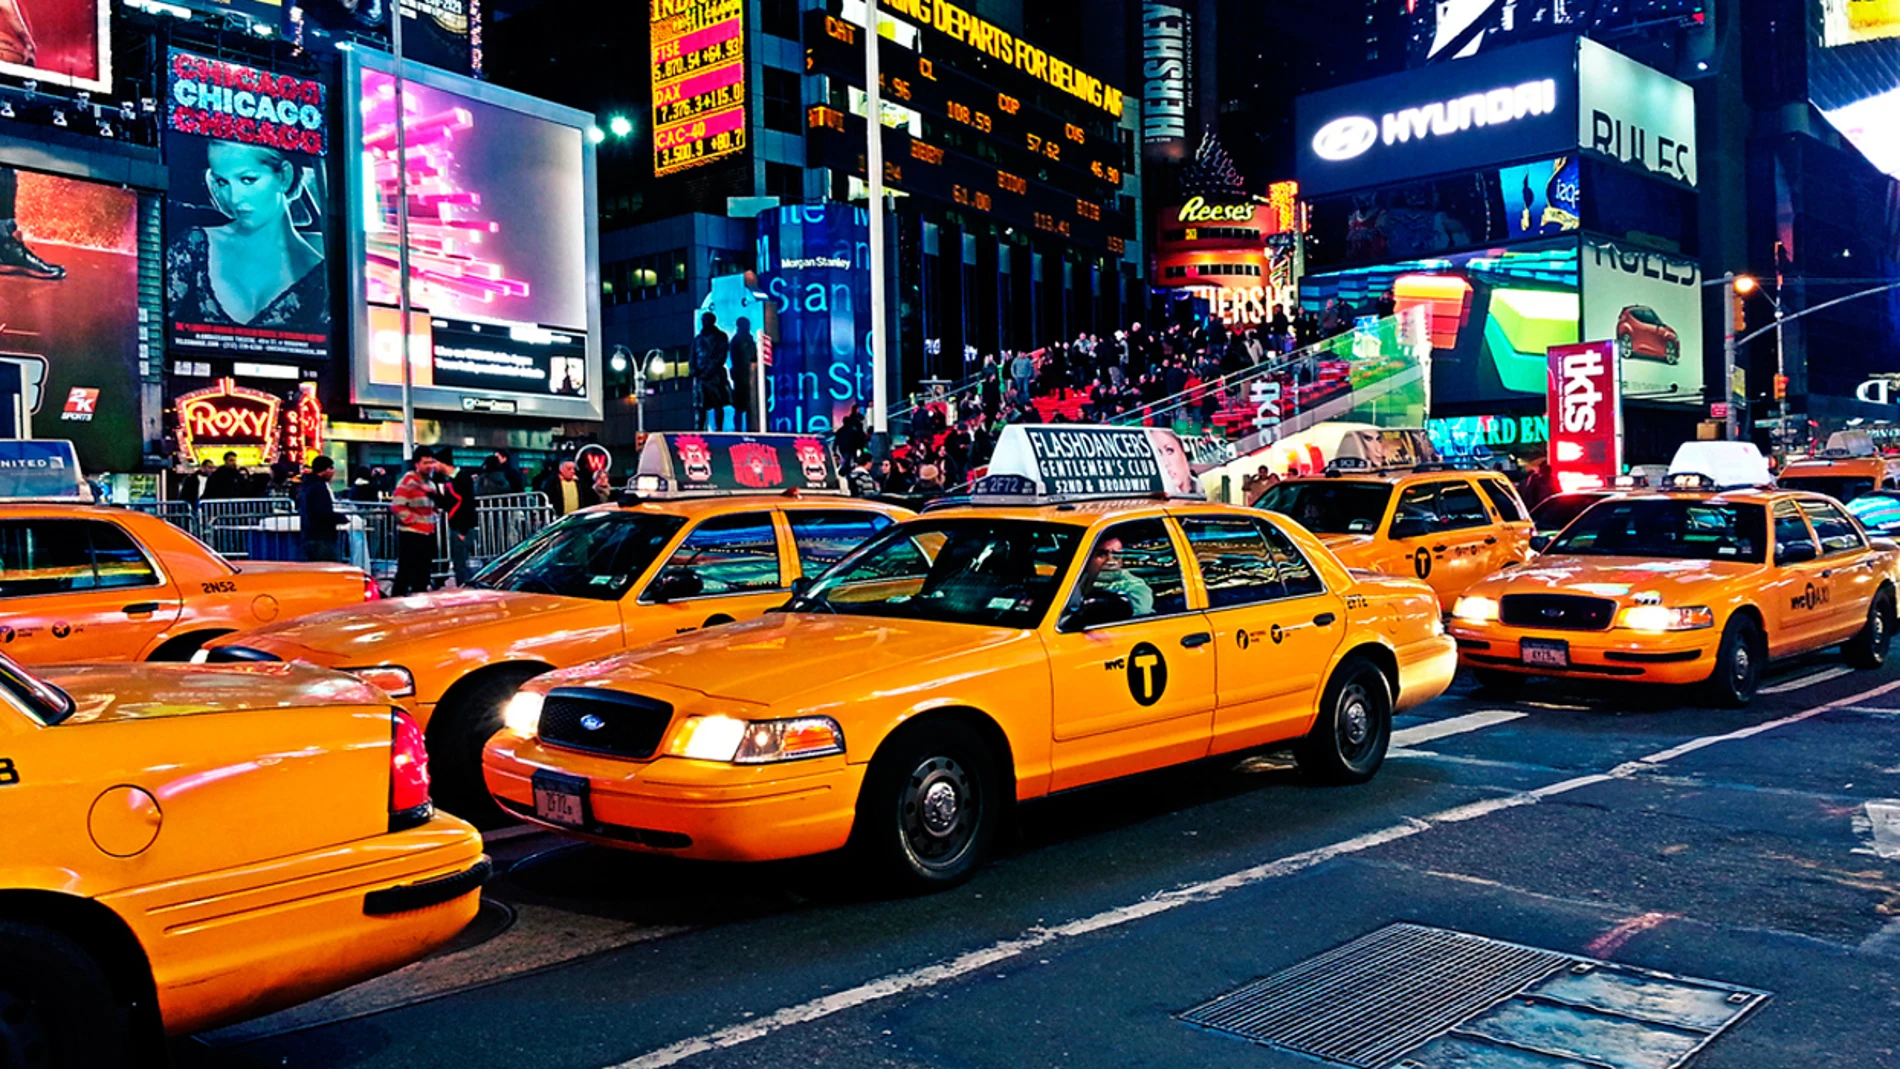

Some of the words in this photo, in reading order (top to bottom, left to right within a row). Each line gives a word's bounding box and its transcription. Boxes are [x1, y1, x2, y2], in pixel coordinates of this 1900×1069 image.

[655, 40, 680, 62] FTSE
[933, 0, 1014, 65] DEPARTS
[1014, 38, 1049, 82] FOR
[1049, 55, 1103, 108] BEIJING
[173, 52, 321, 105] CHICAGO
[173, 79, 322, 130] CHICAGO
[656, 83, 681, 106] DAX
[1382, 78, 1556, 146] HYUNDAI
[173, 105, 322, 154] CHICAGO
[1178, 196, 1255, 222] Reese's
[781, 258, 815, 271] Morgan
[815, 256, 851, 271] Stanley
[1563, 349, 1605, 433] tkts
[187, 401, 268, 437] ROXY
[1029, 432, 1151, 459] FLASHDANCERS
[0, 459, 47, 468] NITED
[1039, 459, 1126, 477] GENTLEMEN'S
[1129, 459, 1158, 476] CLUB
[990, 476, 1018, 493] 2F72
[1055, 480, 1084, 494] 52ND
[1086, 479, 1095, 493] &
[1099, 478, 1152, 493] BROADWAY
[202, 582, 237, 594] 2N52
[1104, 658, 1125, 671] NYC
[1134, 654, 1158, 698] T
